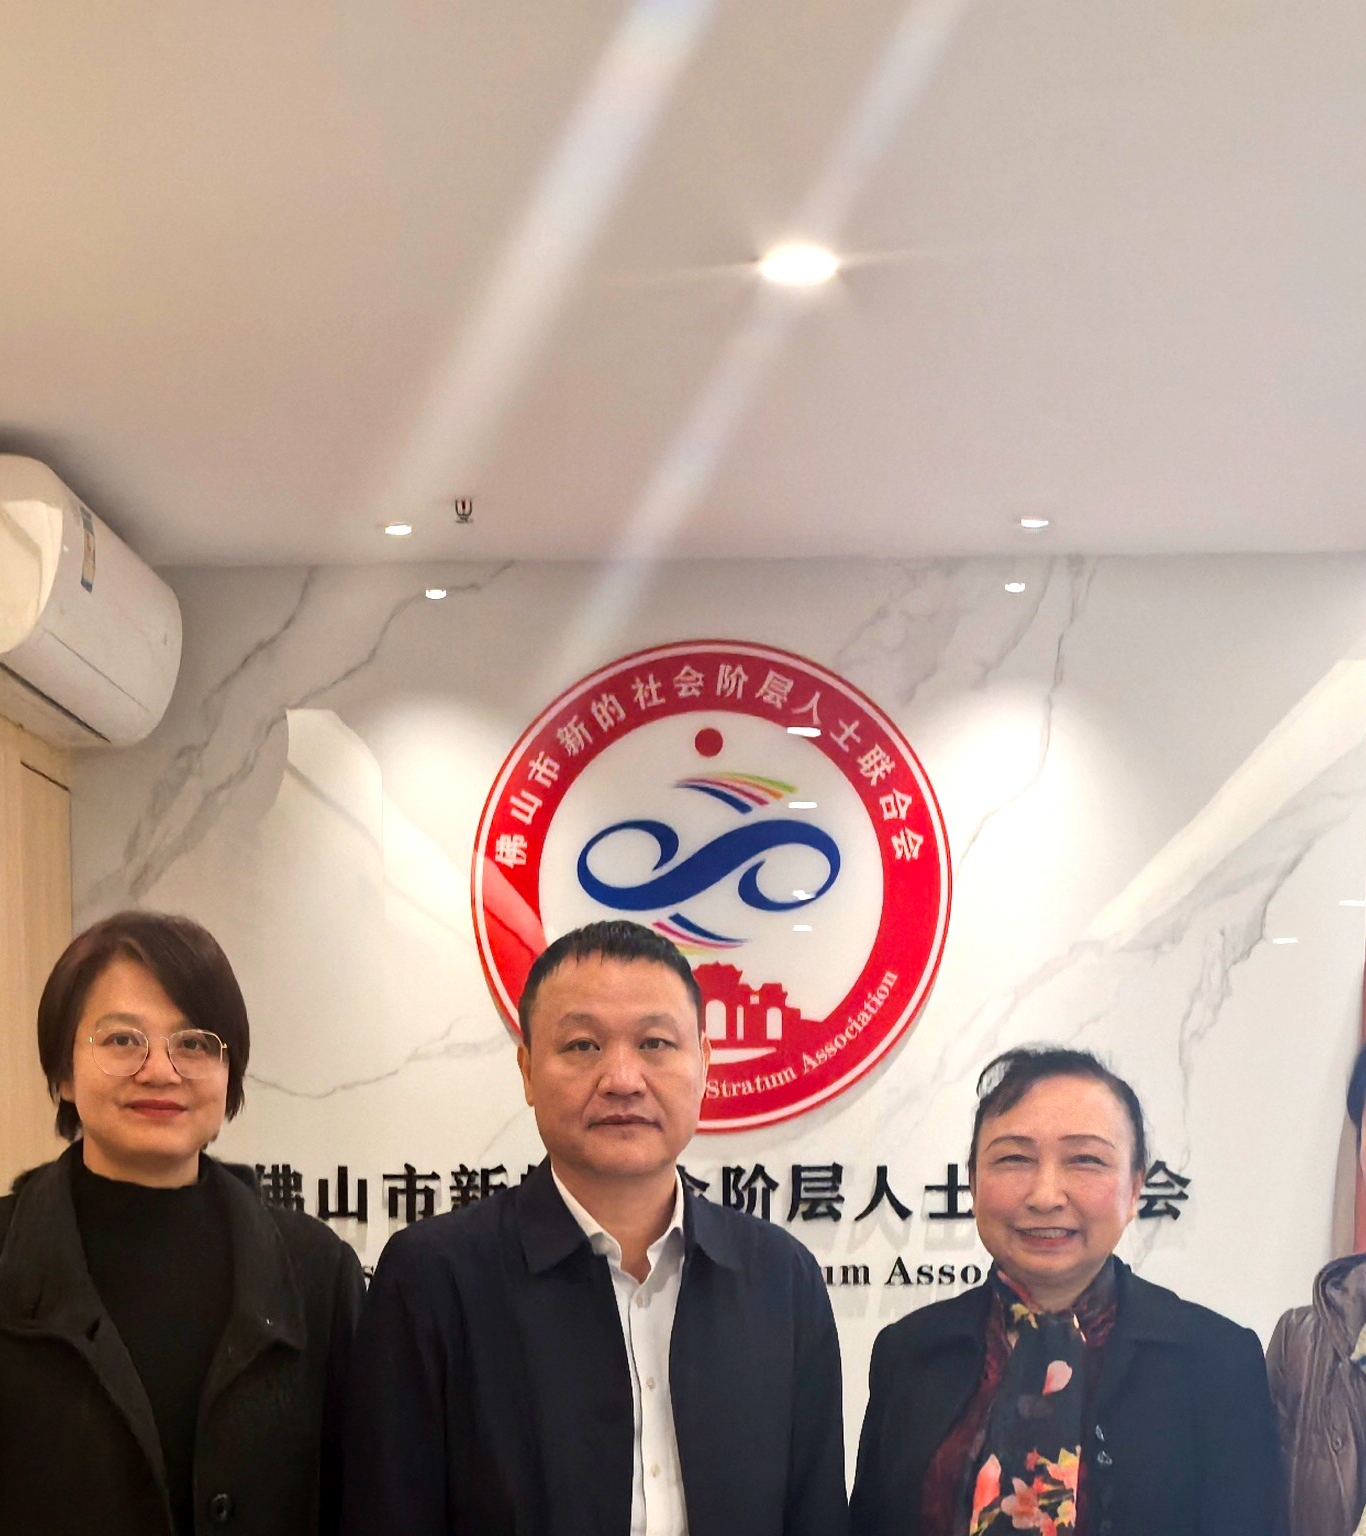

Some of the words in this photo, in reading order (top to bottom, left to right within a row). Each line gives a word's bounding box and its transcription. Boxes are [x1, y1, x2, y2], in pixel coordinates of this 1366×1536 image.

[493, 663, 925, 869] 佛山市新的社会阶层人士联合会
[706, 1066, 798, 1099] Stratum
[801, 970, 899, 1076] Association
